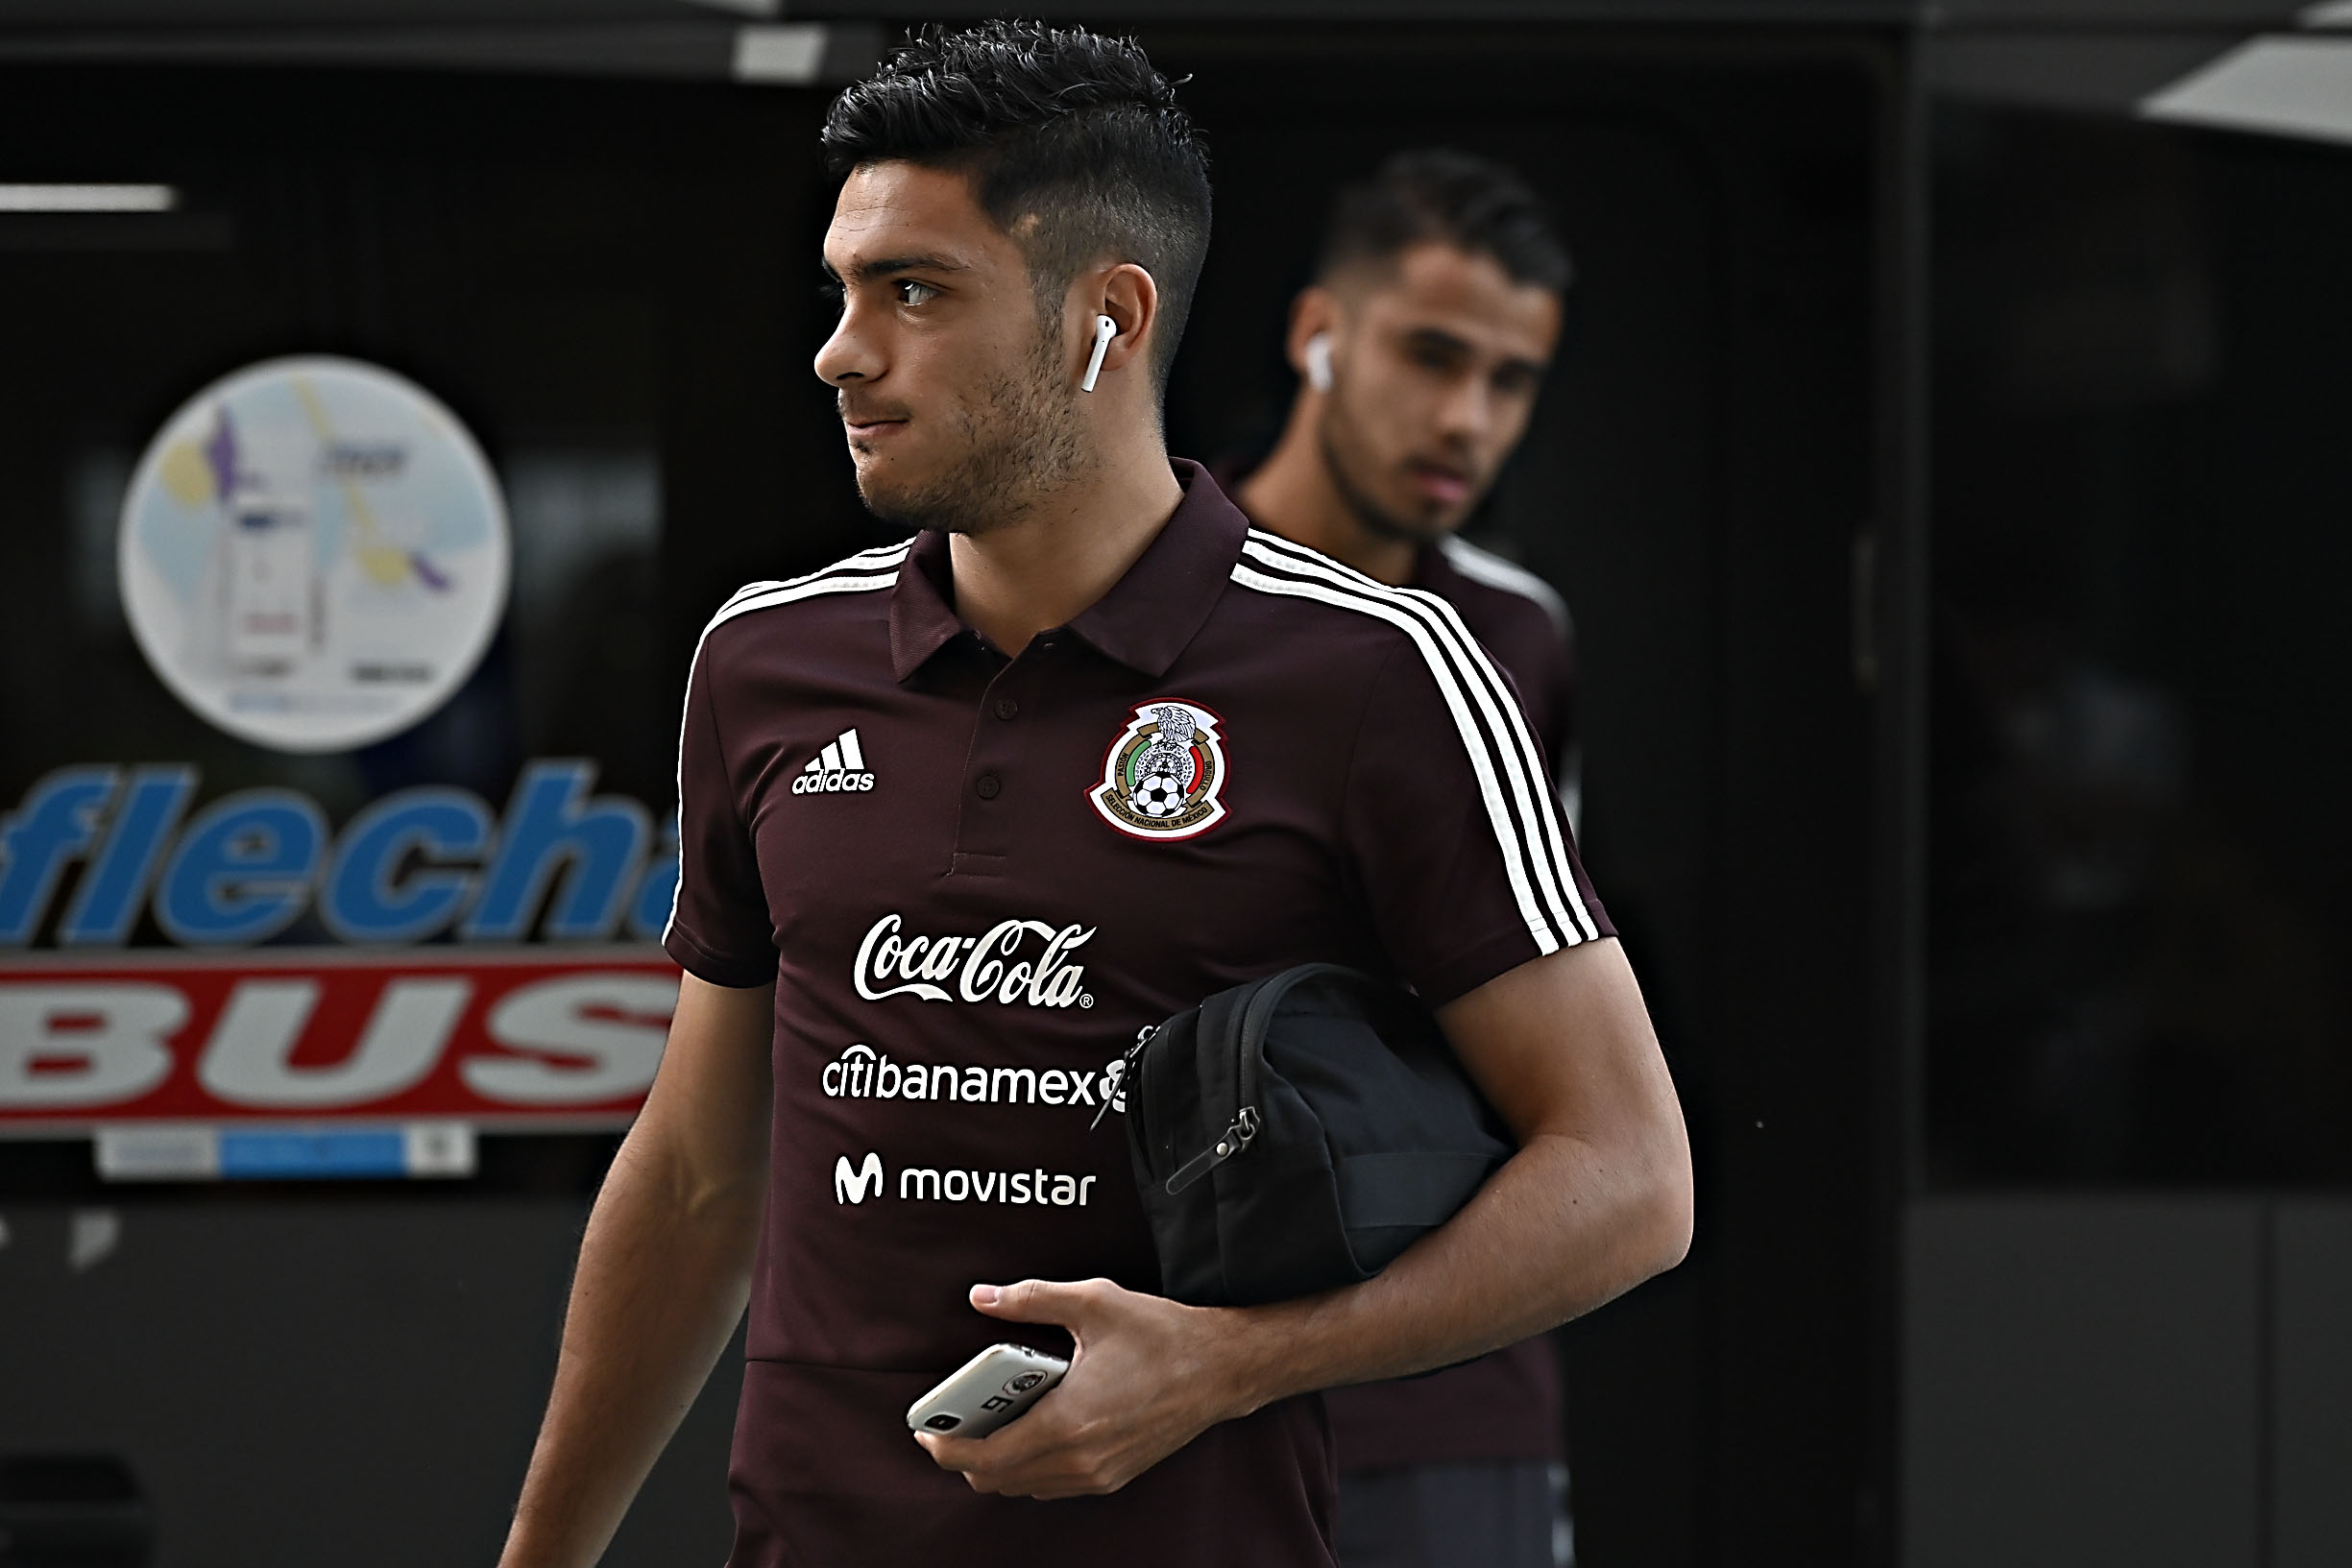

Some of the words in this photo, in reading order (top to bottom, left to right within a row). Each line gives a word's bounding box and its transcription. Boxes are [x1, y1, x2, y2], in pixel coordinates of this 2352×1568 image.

[791, 767, 875, 795] adidas
[1200, 760, 1212, 790] ORGULLO
[1134, 817, 1170, 828] NACIONAL
[1171, 817, 1181, 828] DE
[0, 755, 681, 945] flech
[853, 913, 1098, 1008] Coca-Cola
[0, 973, 682, 1110] BUS
[822, 1045, 1097, 1106] citibanamex
[900, 1168, 1097, 1206] movistar
